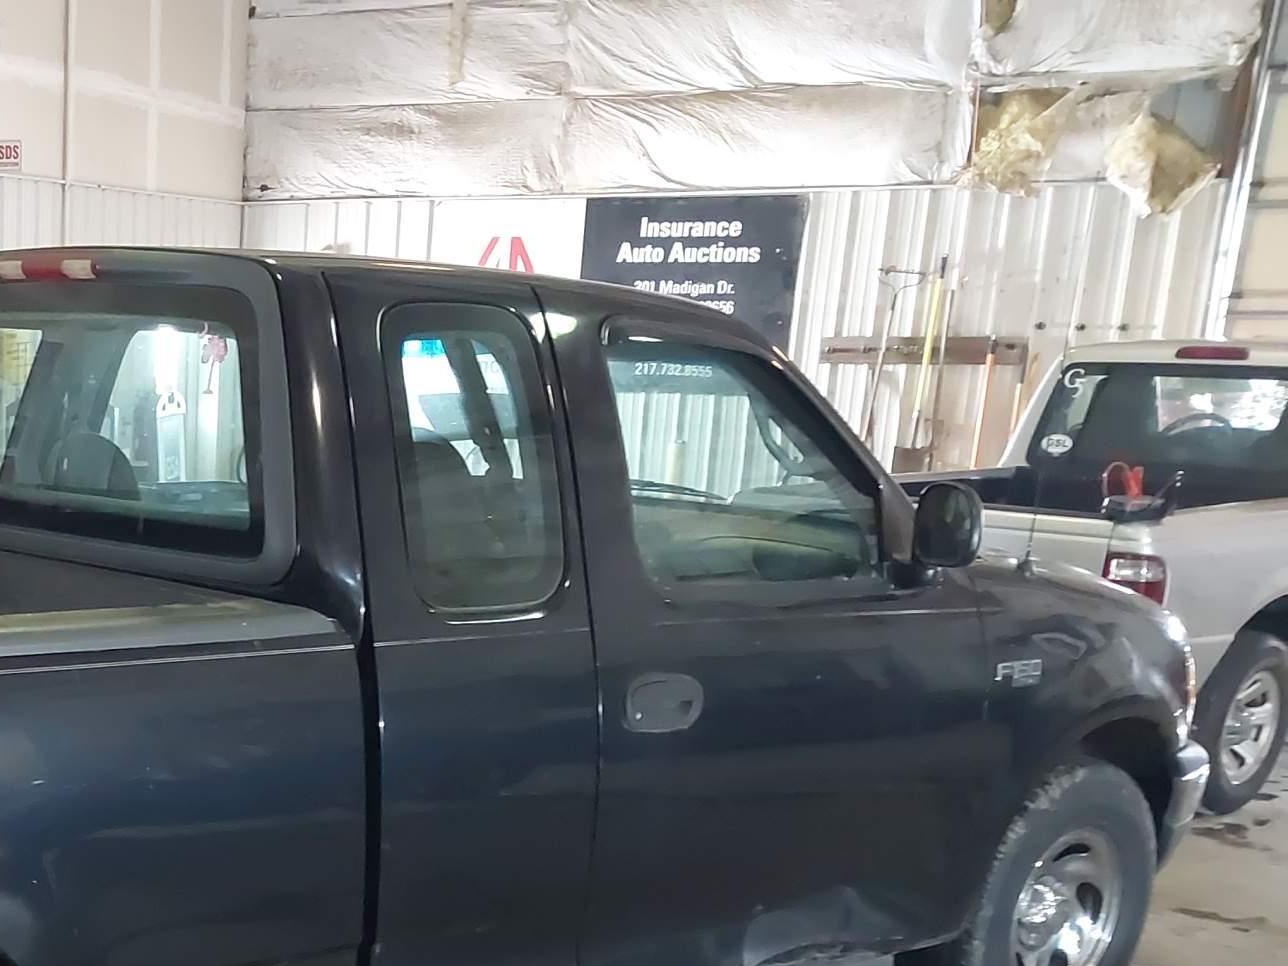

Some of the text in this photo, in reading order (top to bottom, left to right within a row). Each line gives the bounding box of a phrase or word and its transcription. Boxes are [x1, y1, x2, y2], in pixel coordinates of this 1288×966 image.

[640, 216, 743, 238] Insurance
[616, 241, 761, 263] Auto Auctions
[659, 280, 715, 297] Madigan
[717, 280, 735, 294] Dr.
